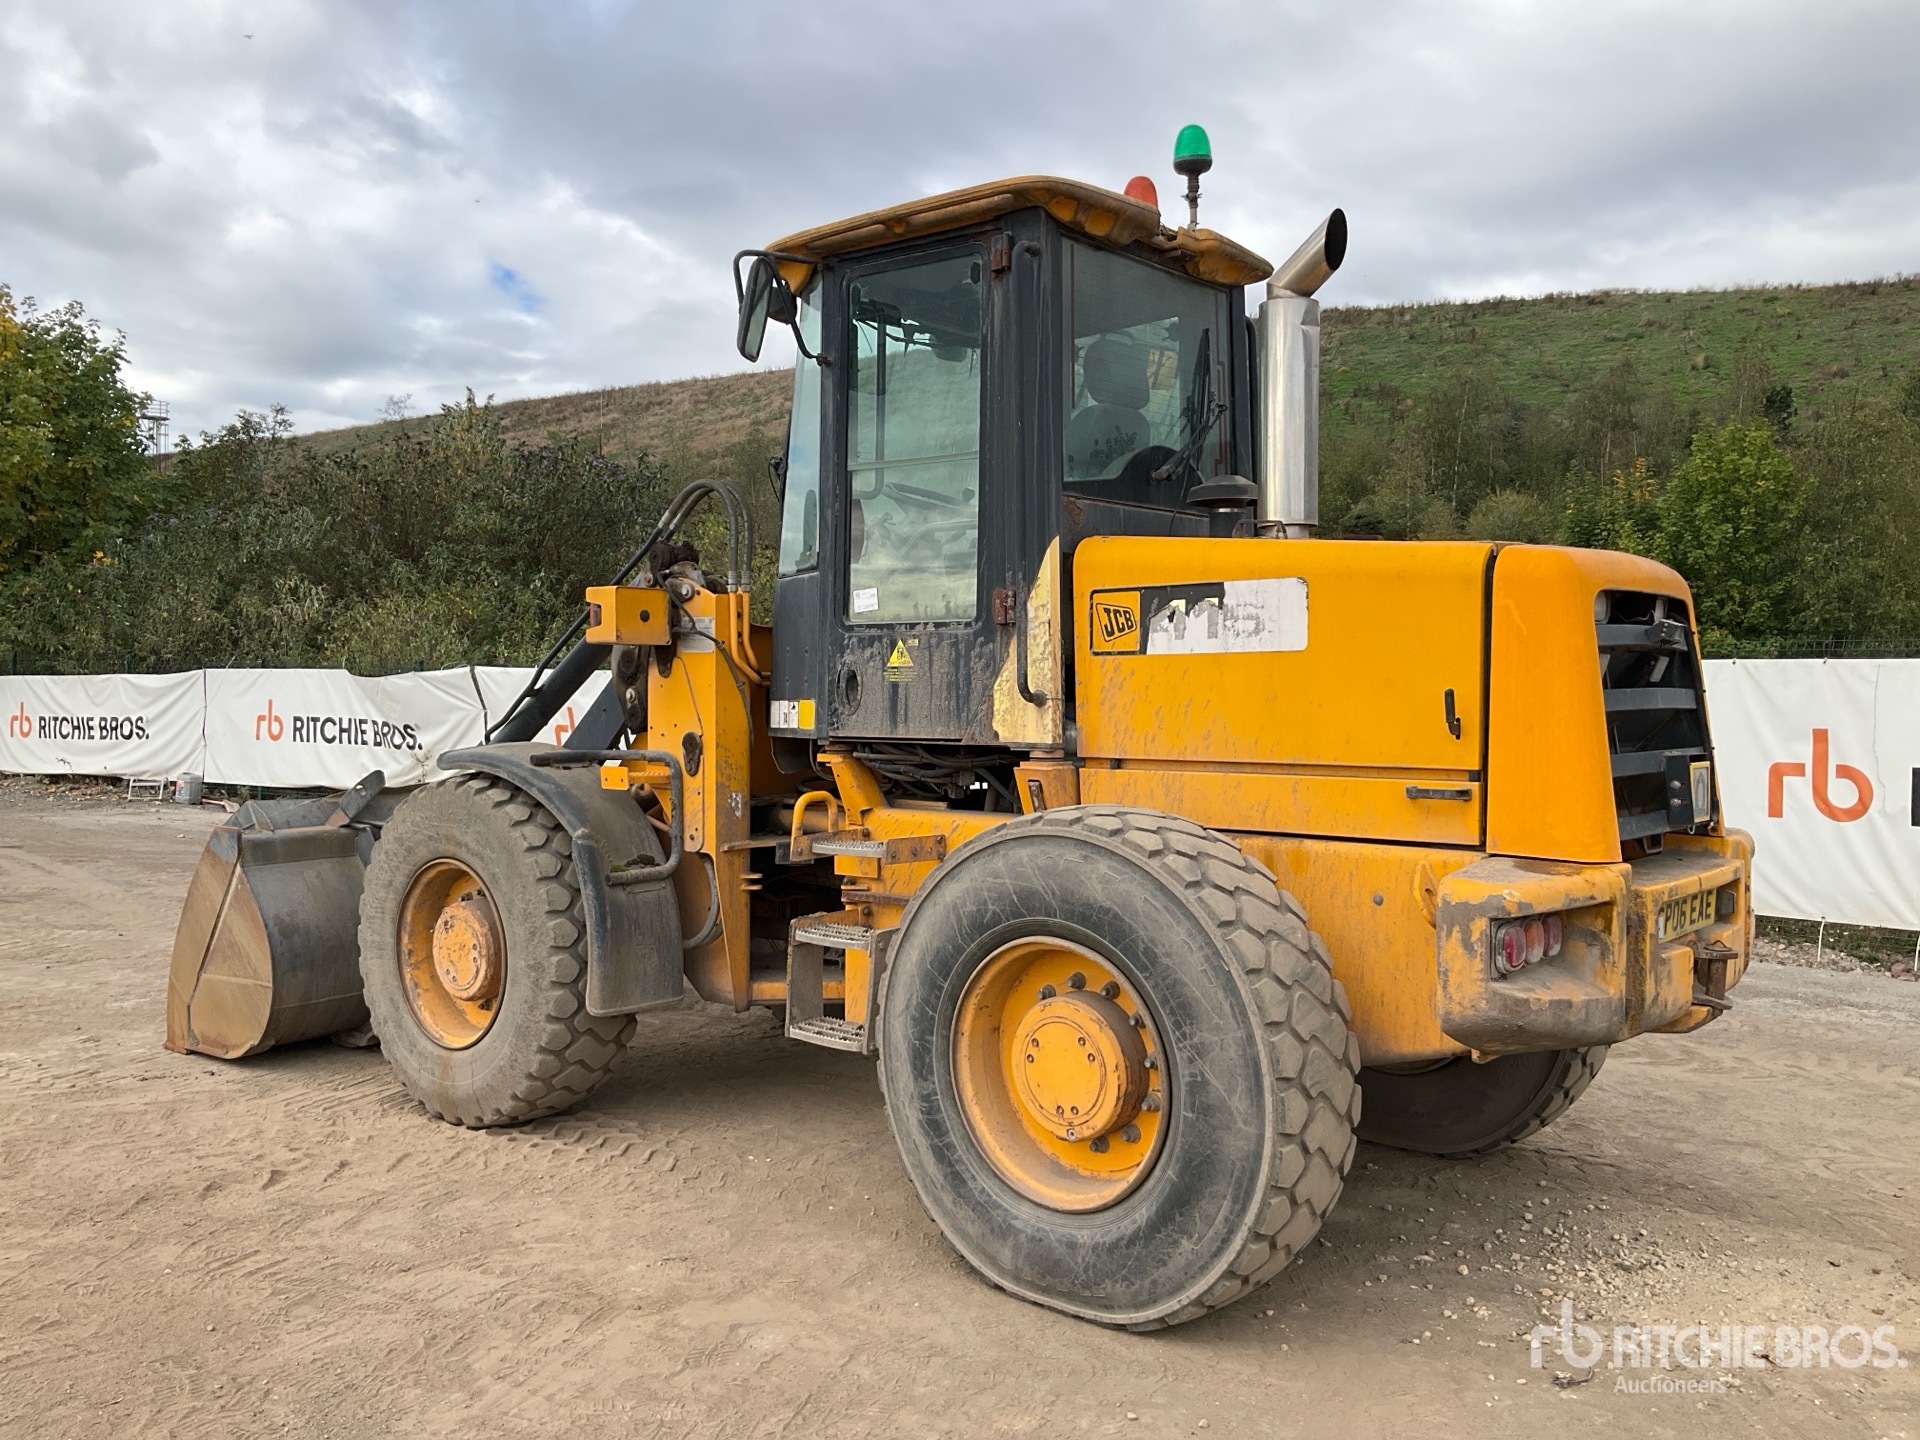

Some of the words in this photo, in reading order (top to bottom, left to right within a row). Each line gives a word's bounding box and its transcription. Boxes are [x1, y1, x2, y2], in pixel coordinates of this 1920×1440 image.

[1102, 606, 1135, 637] JCB
[10, 701, 32, 738] rb
[38, 715, 95, 739] RITCHIE
[98, 715, 150, 740] BROS.
[255, 698, 284, 742] rb
[292, 715, 368, 745] RITCHIE
[371, 719, 423, 751] BROS.
[1767, 728, 1874, 822] rb
[1689, 889, 1714, 926] EAE
